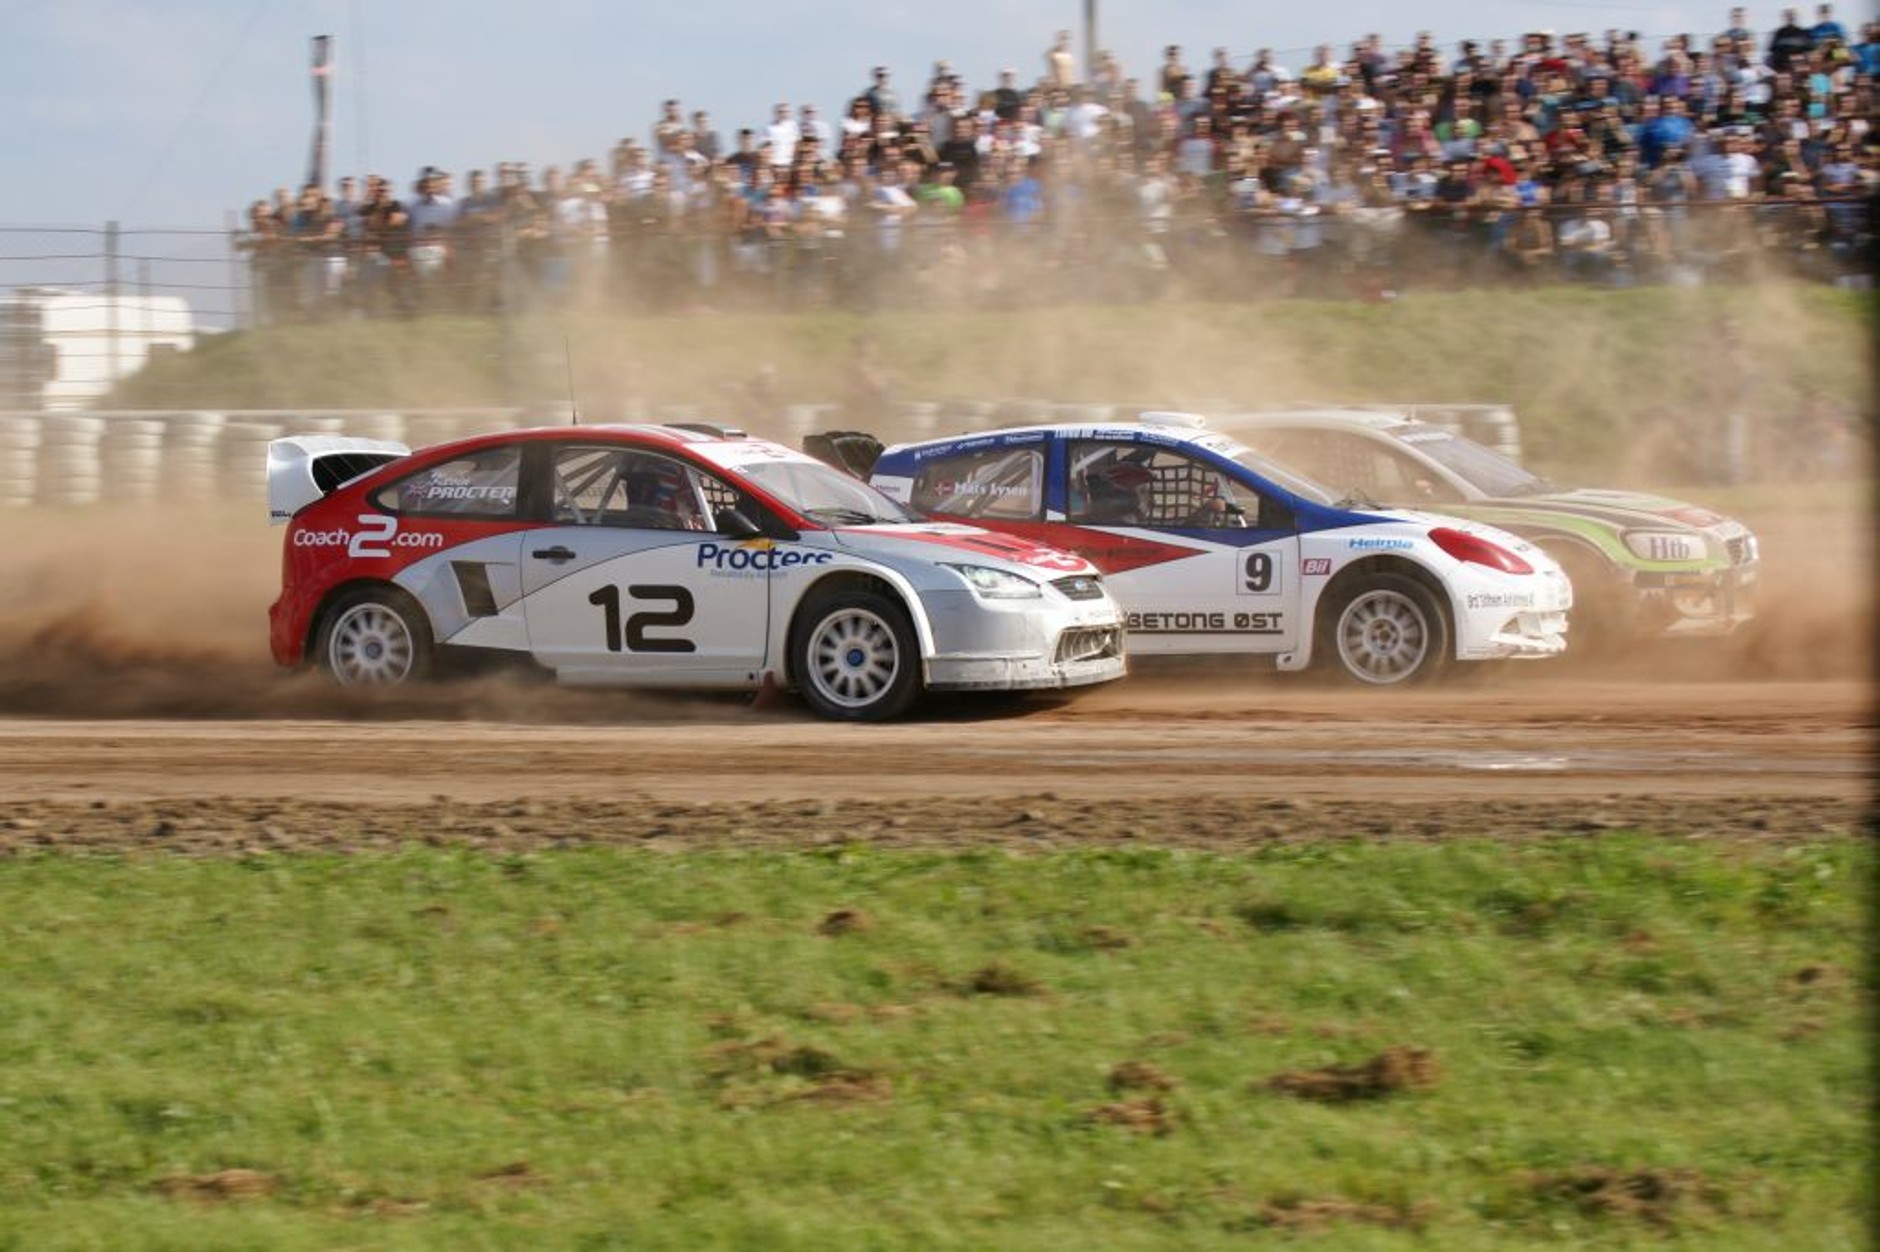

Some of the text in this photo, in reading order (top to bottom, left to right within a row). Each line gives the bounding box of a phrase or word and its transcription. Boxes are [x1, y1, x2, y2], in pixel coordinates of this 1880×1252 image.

[426, 486, 517, 499] PROCTER
[1245, 552, 1273, 592] 9
[1304, 560, 1327, 574] Bil
[588, 583, 697, 653] 12
[1127, 612, 1284, 629] BETONG ØST
